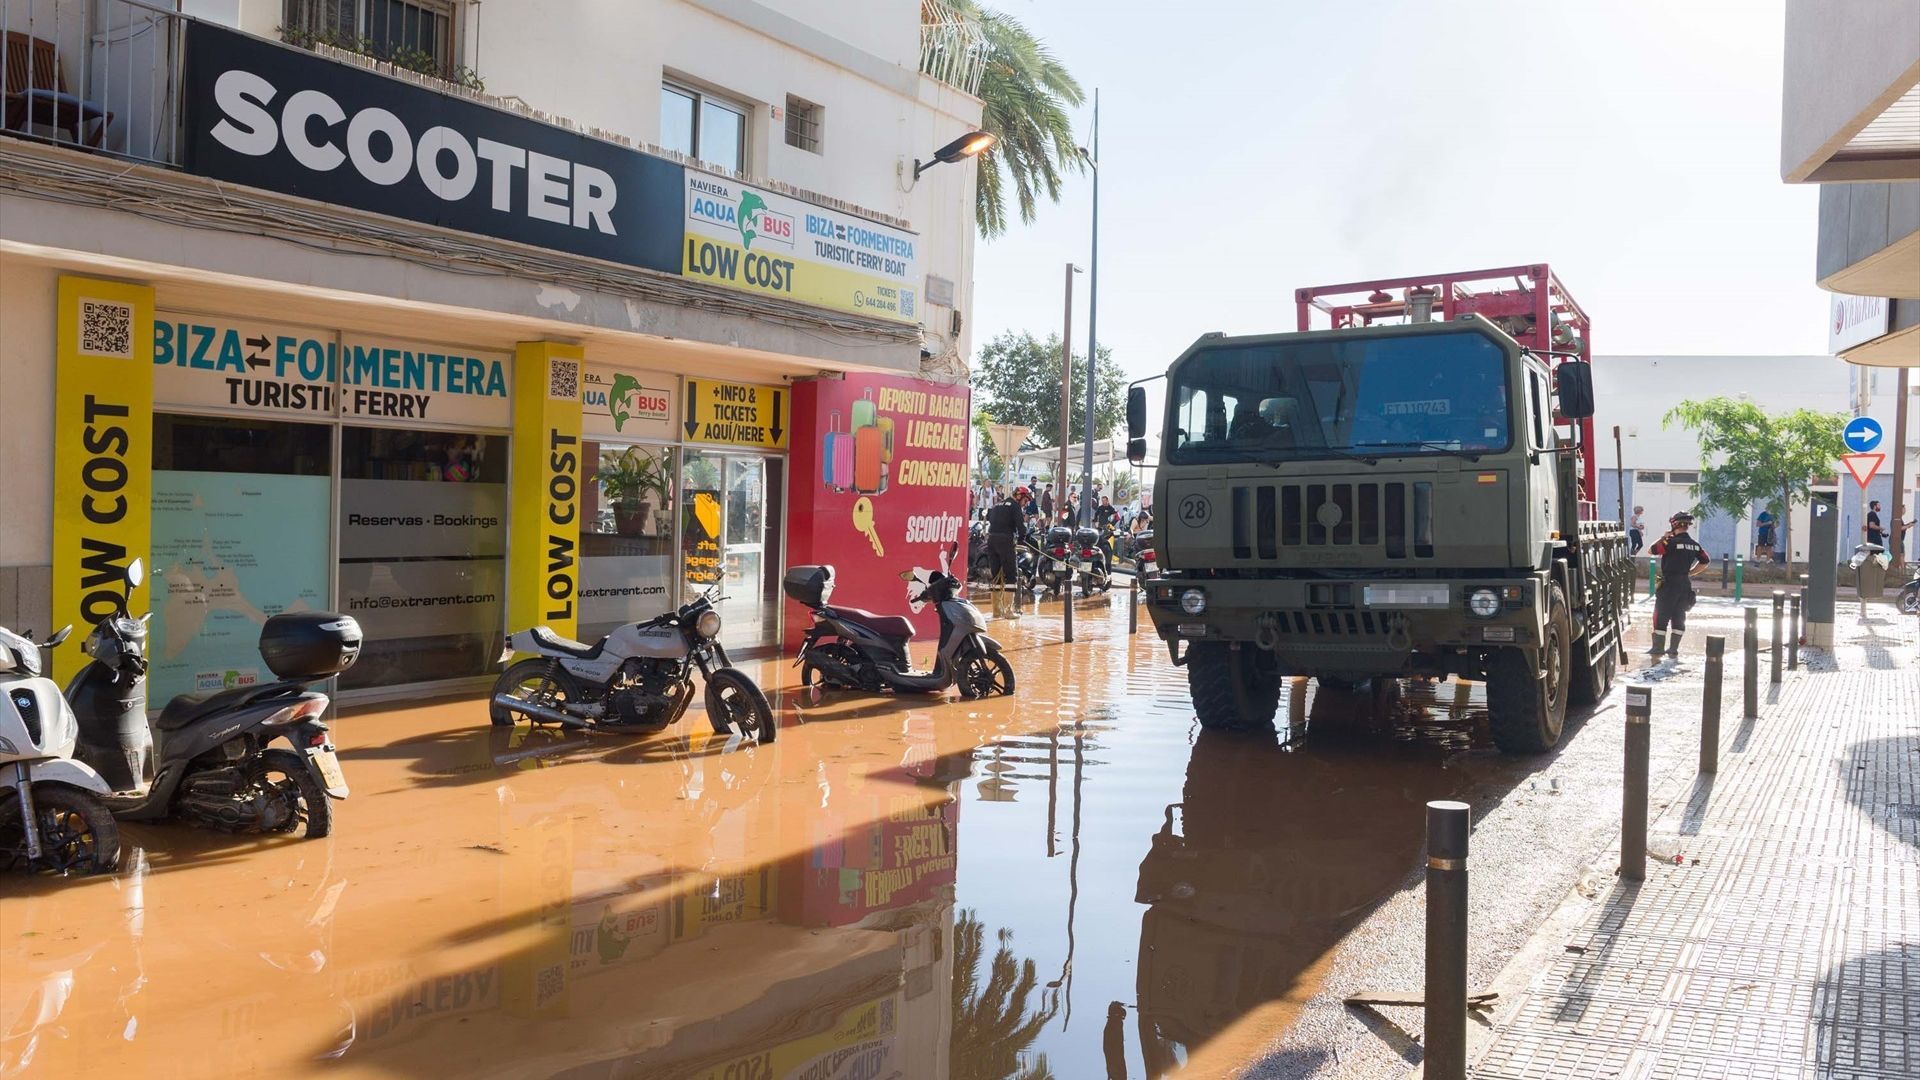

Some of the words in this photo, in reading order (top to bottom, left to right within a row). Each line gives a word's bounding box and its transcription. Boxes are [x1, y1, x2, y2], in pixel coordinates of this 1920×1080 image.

[210, 69, 618, 236] SCOOTER
[690, 178, 729, 197] NAVIERA
[693, 198, 736, 224] AQUA
[763, 216, 791, 237] BUS
[805, 214, 835, 239] IBIZA
[847, 226, 914, 260] FORMENTERA
[689, 239, 739, 281] LOW
[744, 252, 795, 292] COST
[814, 241, 855, 265] TURISTIC
[856, 251, 884, 271] FERRY
[885, 261, 906, 276] BOAT
[877, 286, 897, 299] TICKETS
[153, 320, 246, 373] BIZA
[275, 336, 507, 397] FORMENTERA
[584, 373, 601, 383] ERA
[354, 389, 430, 419] FERRY
[638, 396, 667, 412] BUS
[713, 385, 746, 403] +INFO
[749, 387, 756, 404] &
[878, 387, 926, 415] DEPOSITO
[929, 393, 967, 420] BAGAGLI
[714, 404, 757, 421] TICKETS
[704, 421, 764, 443] AQUÍ/HERE
[905, 419, 966, 452] LUGGAGE
[81, 394, 129, 524] COST
[549, 428, 577, 525] COST
[898, 459, 967, 488] CONSIGNA
[349, 514, 423, 526] Reservas
[434, 514, 498, 529] Bookings
[1184, 501, 1206, 520] 28
[1816, 504, 1828, 517] P
[905, 510, 963, 543] scooter
[546, 534, 574, 620] LOW
[80, 537, 127, 653] OW
[350, 593, 495, 610] info@extrarent.com
[199, 677, 223, 689] AQUA
[238, 676, 255, 685] BUS
